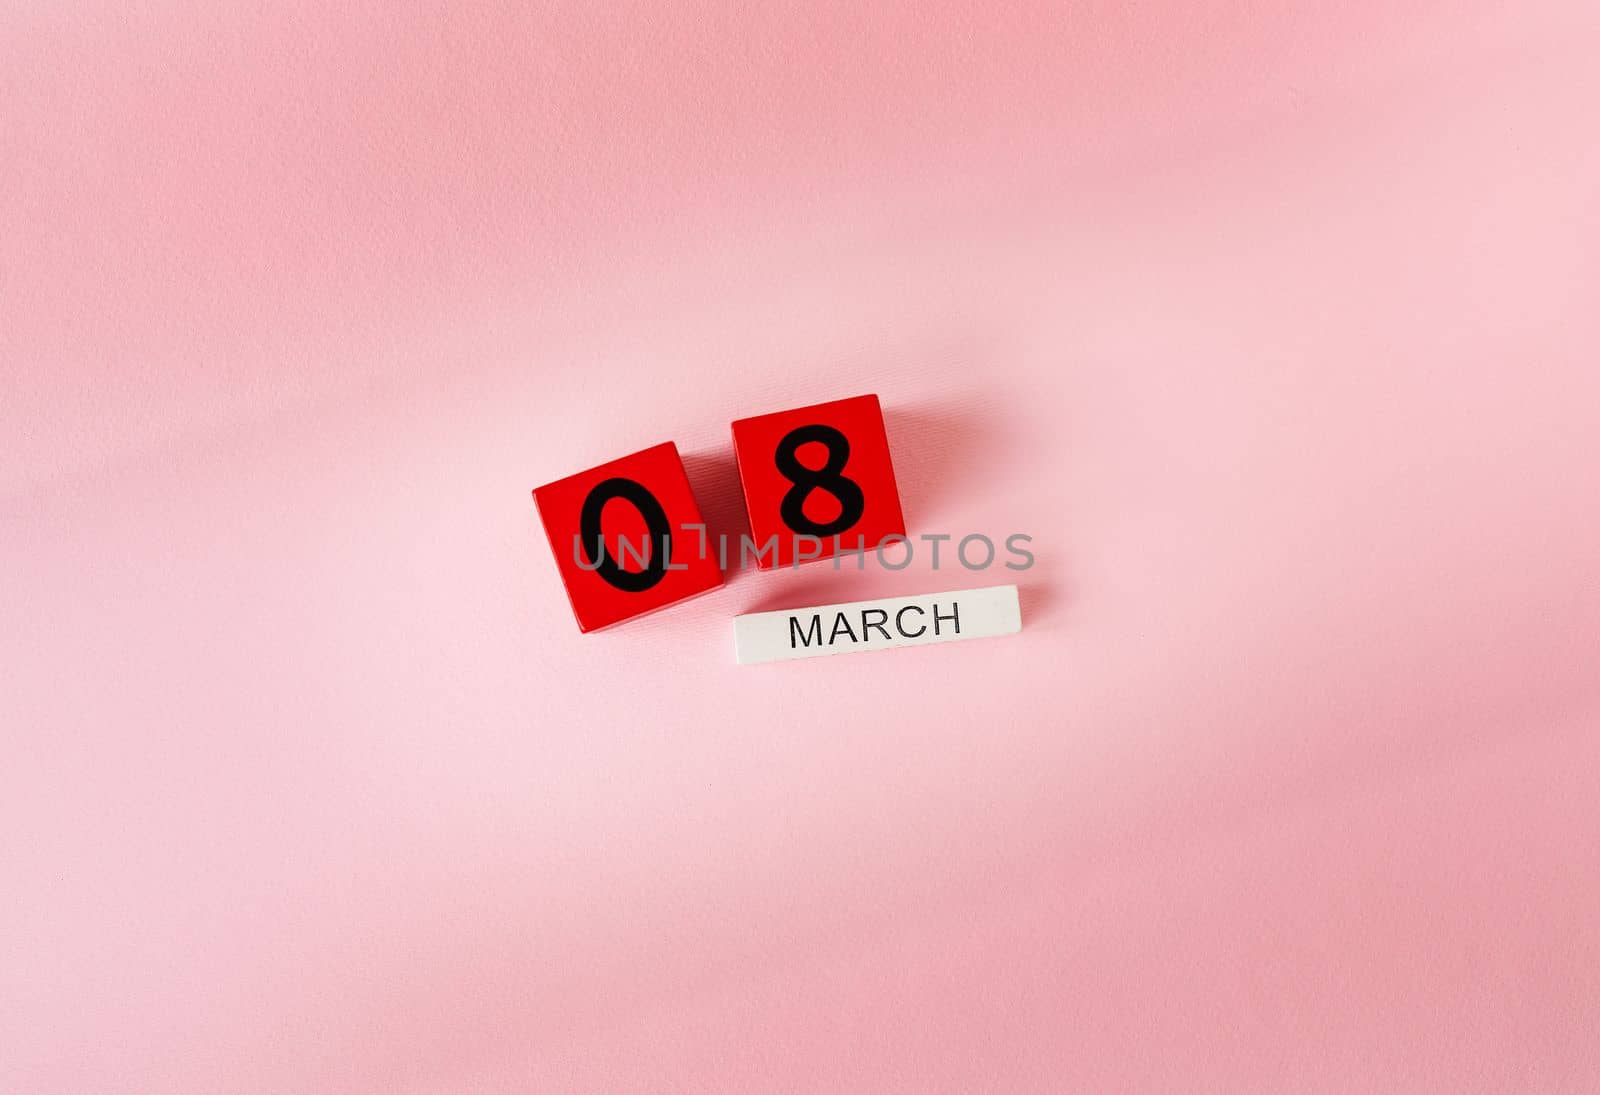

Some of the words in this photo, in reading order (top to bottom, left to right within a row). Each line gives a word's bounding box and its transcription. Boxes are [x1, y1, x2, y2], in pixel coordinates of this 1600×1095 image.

[580, 477, 673, 593] 0
[775, 424, 865, 538] 8
[788, 602, 962, 649] MARCH
